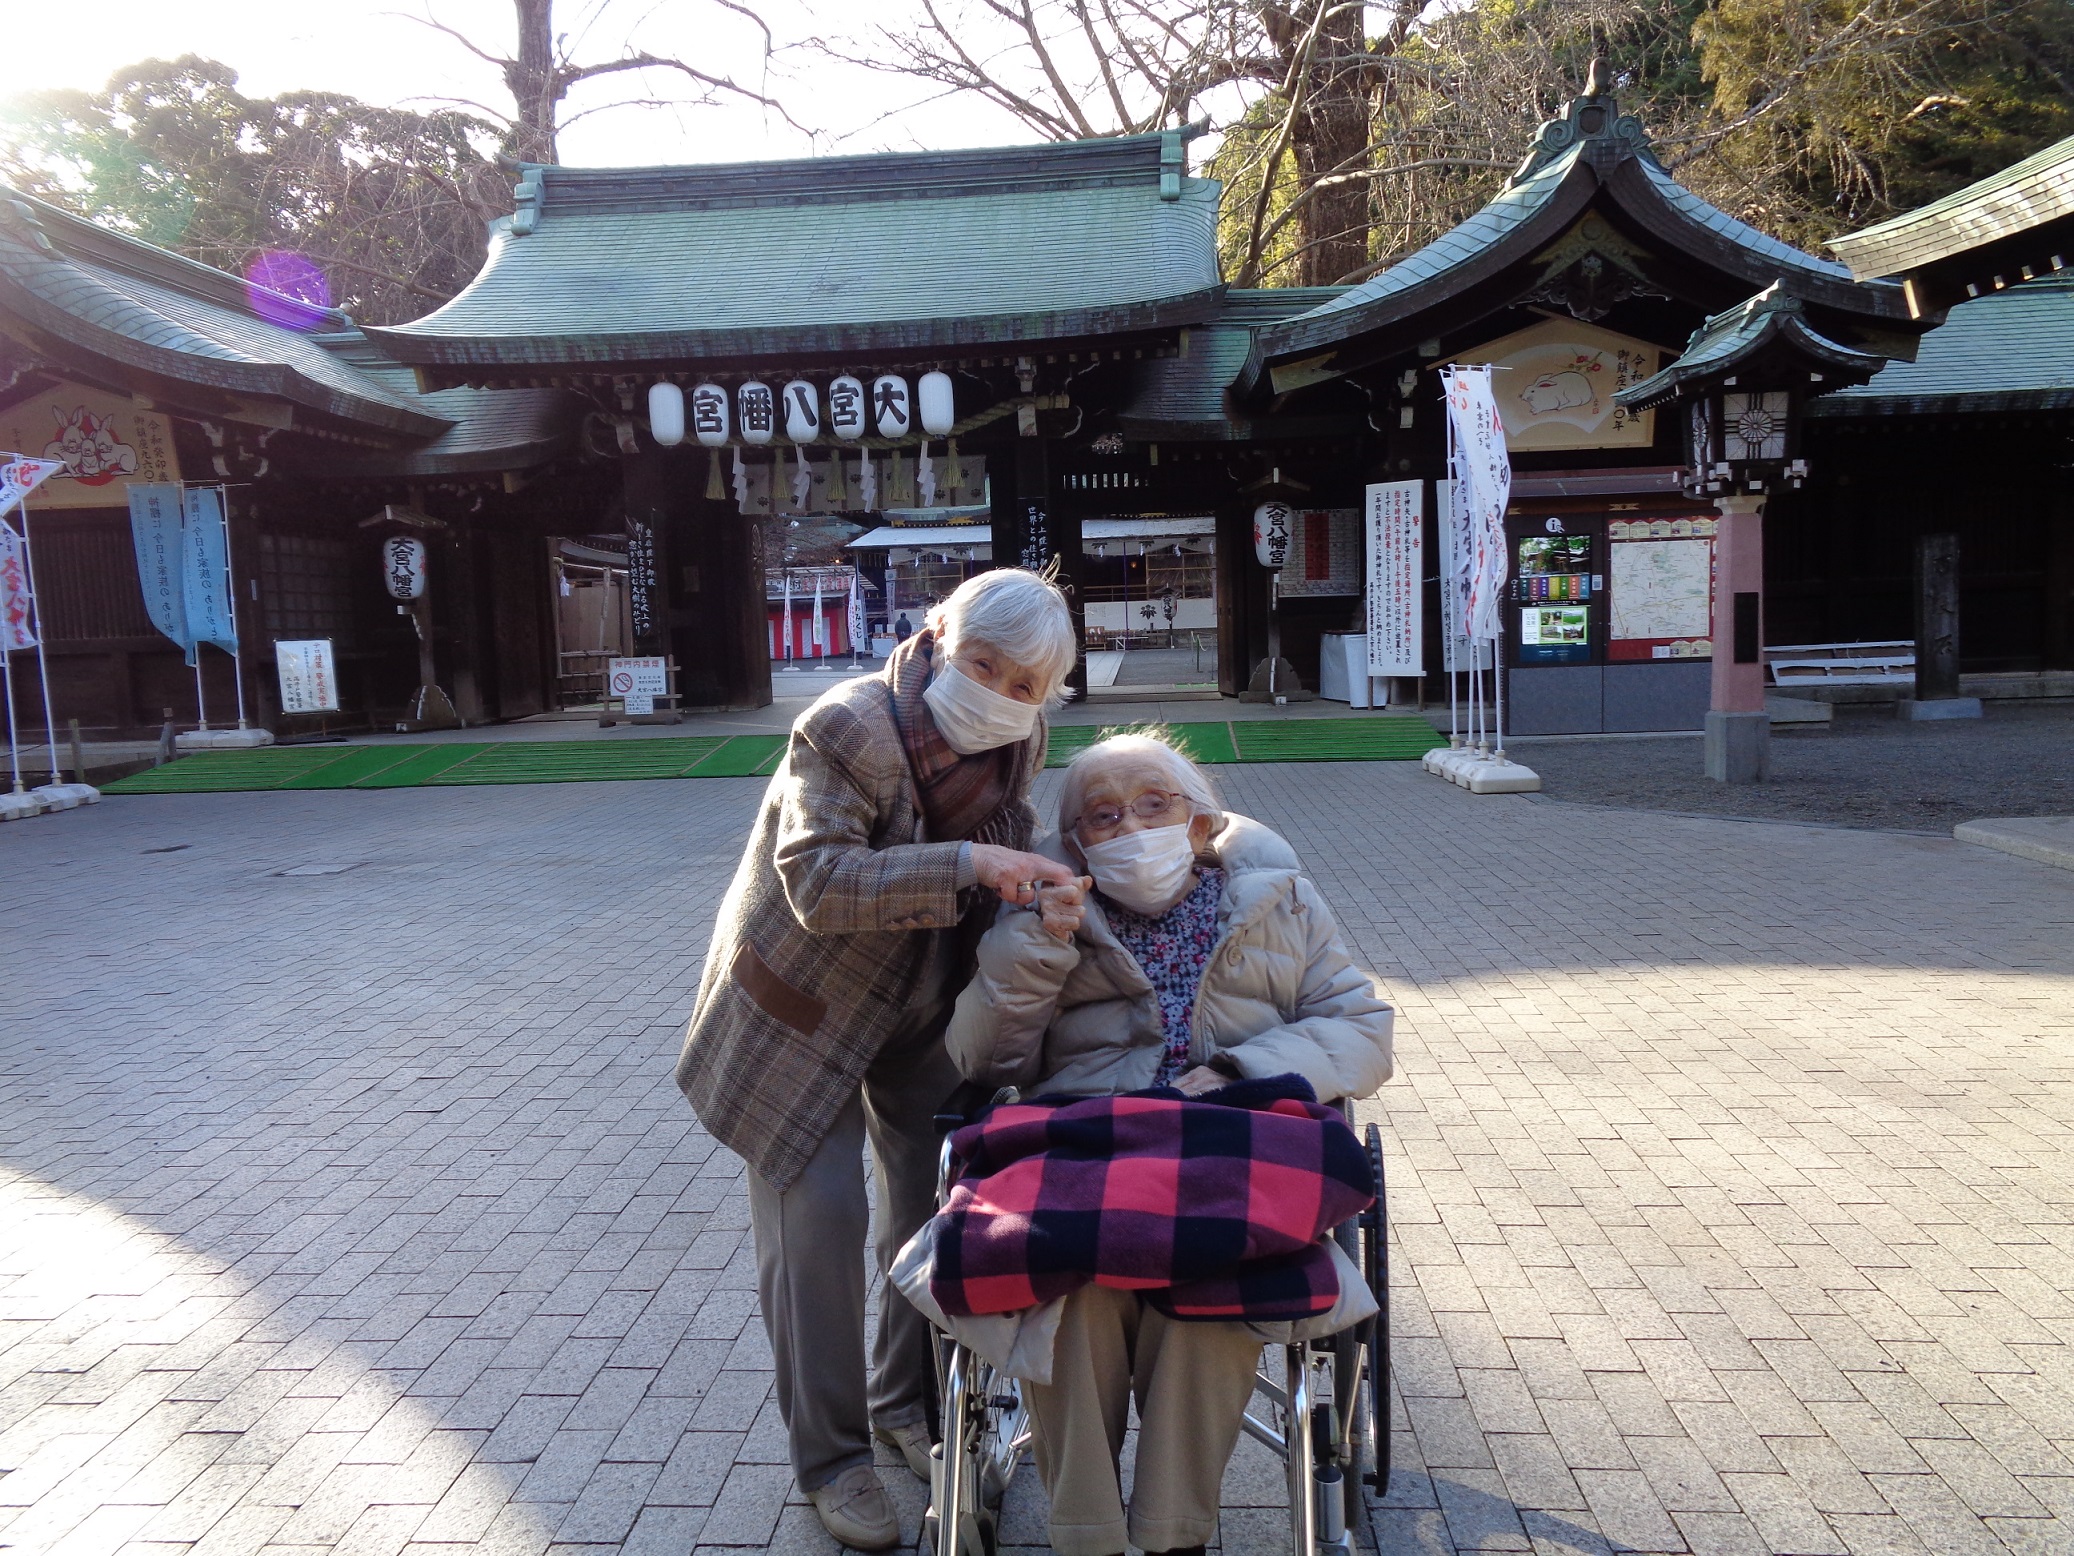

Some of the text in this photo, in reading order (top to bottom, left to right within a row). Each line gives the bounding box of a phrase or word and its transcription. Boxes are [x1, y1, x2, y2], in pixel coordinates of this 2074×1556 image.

[1612, 349, 1630, 431] 御鎮座〇年
[1627, 353, 1646, 423] 令和歳
[133, 415, 155, 484] 御鎮座九六〇
[1265, 504, 1290, 564] 大宮八幡宮
[390, 538, 415, 597] 大宮八幡宮
[855, 604, 863, 640] おみくじ
